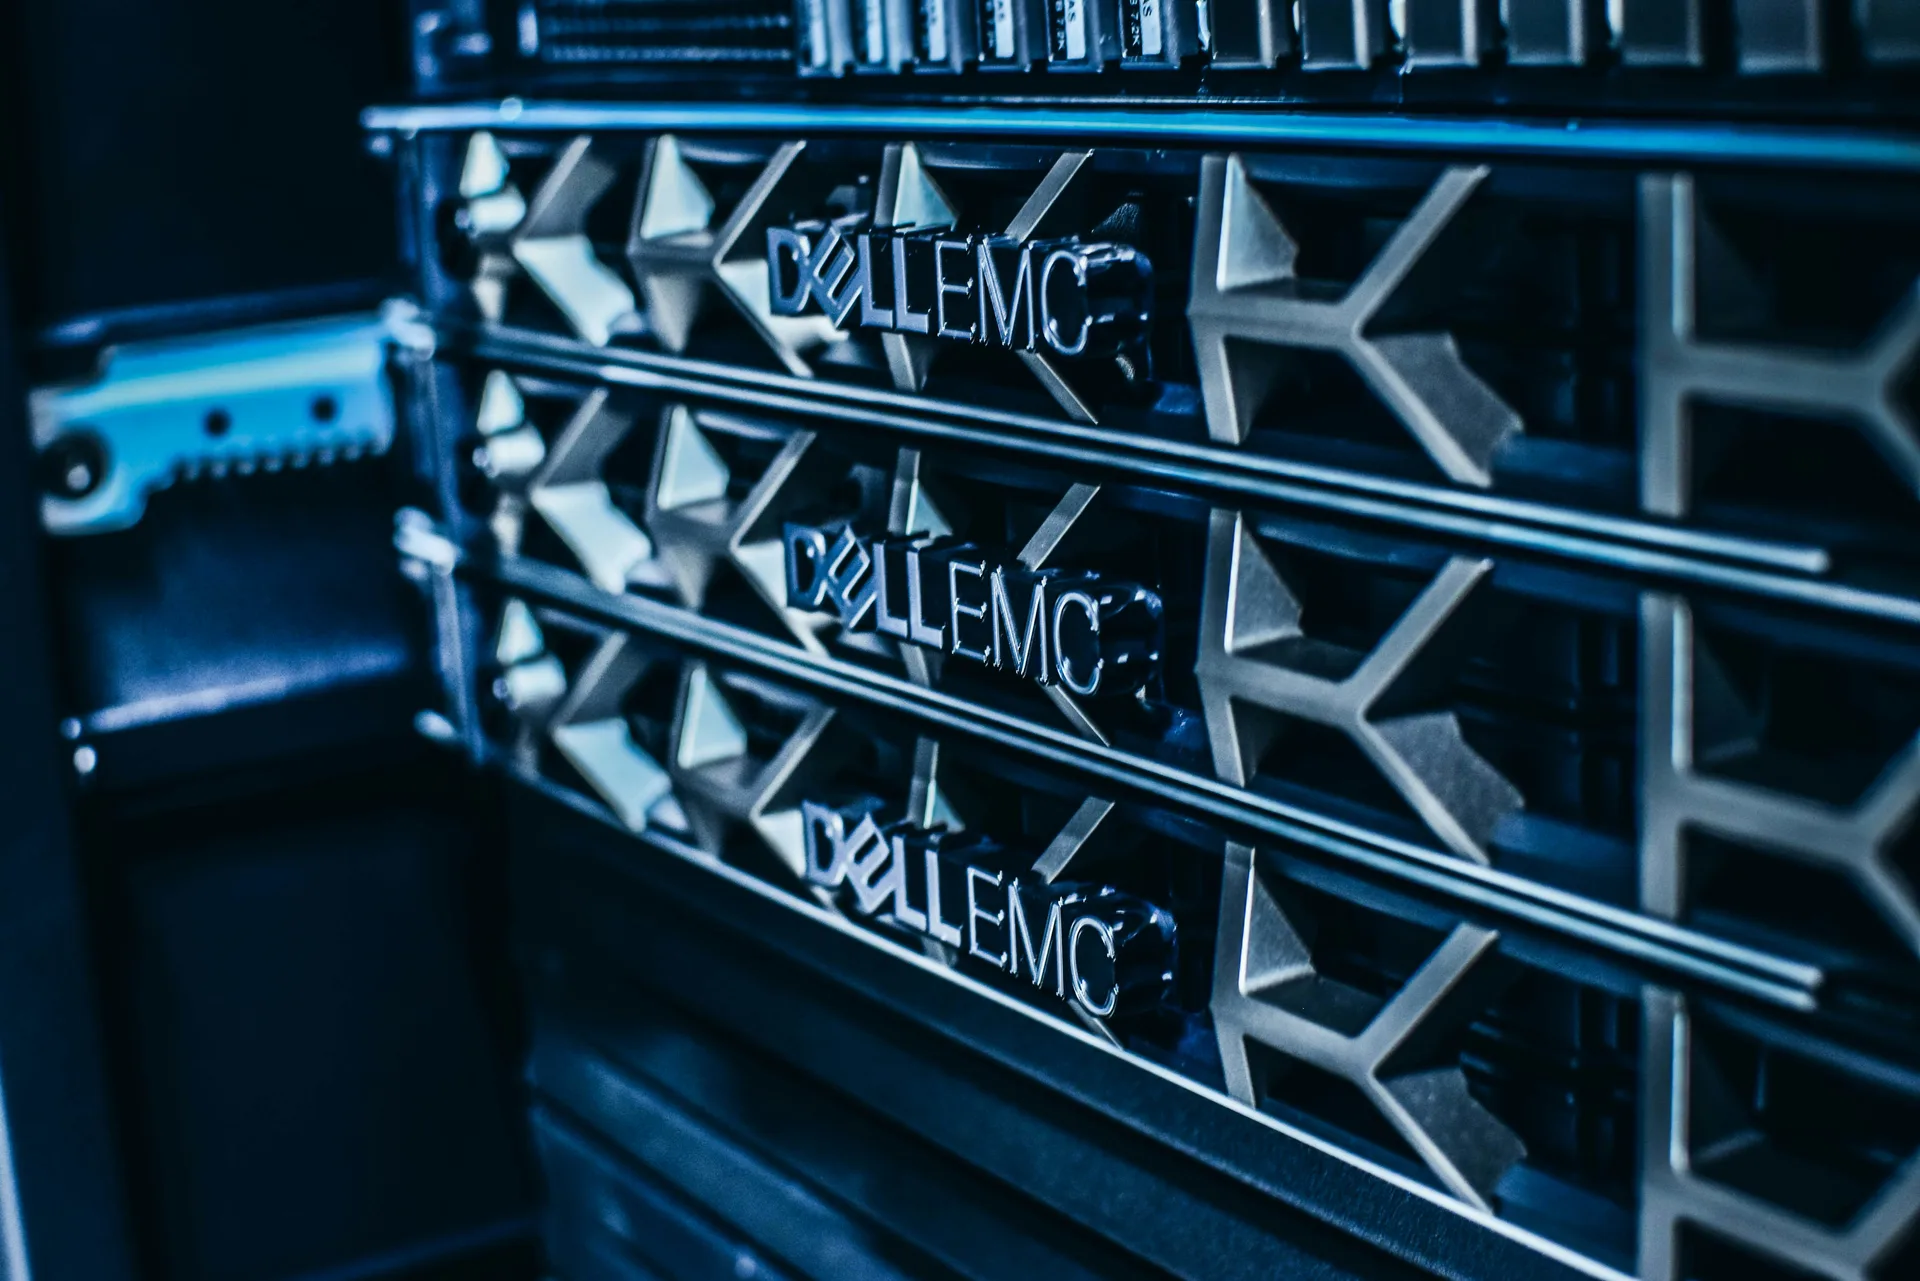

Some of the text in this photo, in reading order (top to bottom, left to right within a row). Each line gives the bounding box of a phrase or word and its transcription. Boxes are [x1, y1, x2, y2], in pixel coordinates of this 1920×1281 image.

[768, 224, 930, 335] DELL
[783, 521, 946, 650] DELL
[801, 799, 963, 948] DELL
